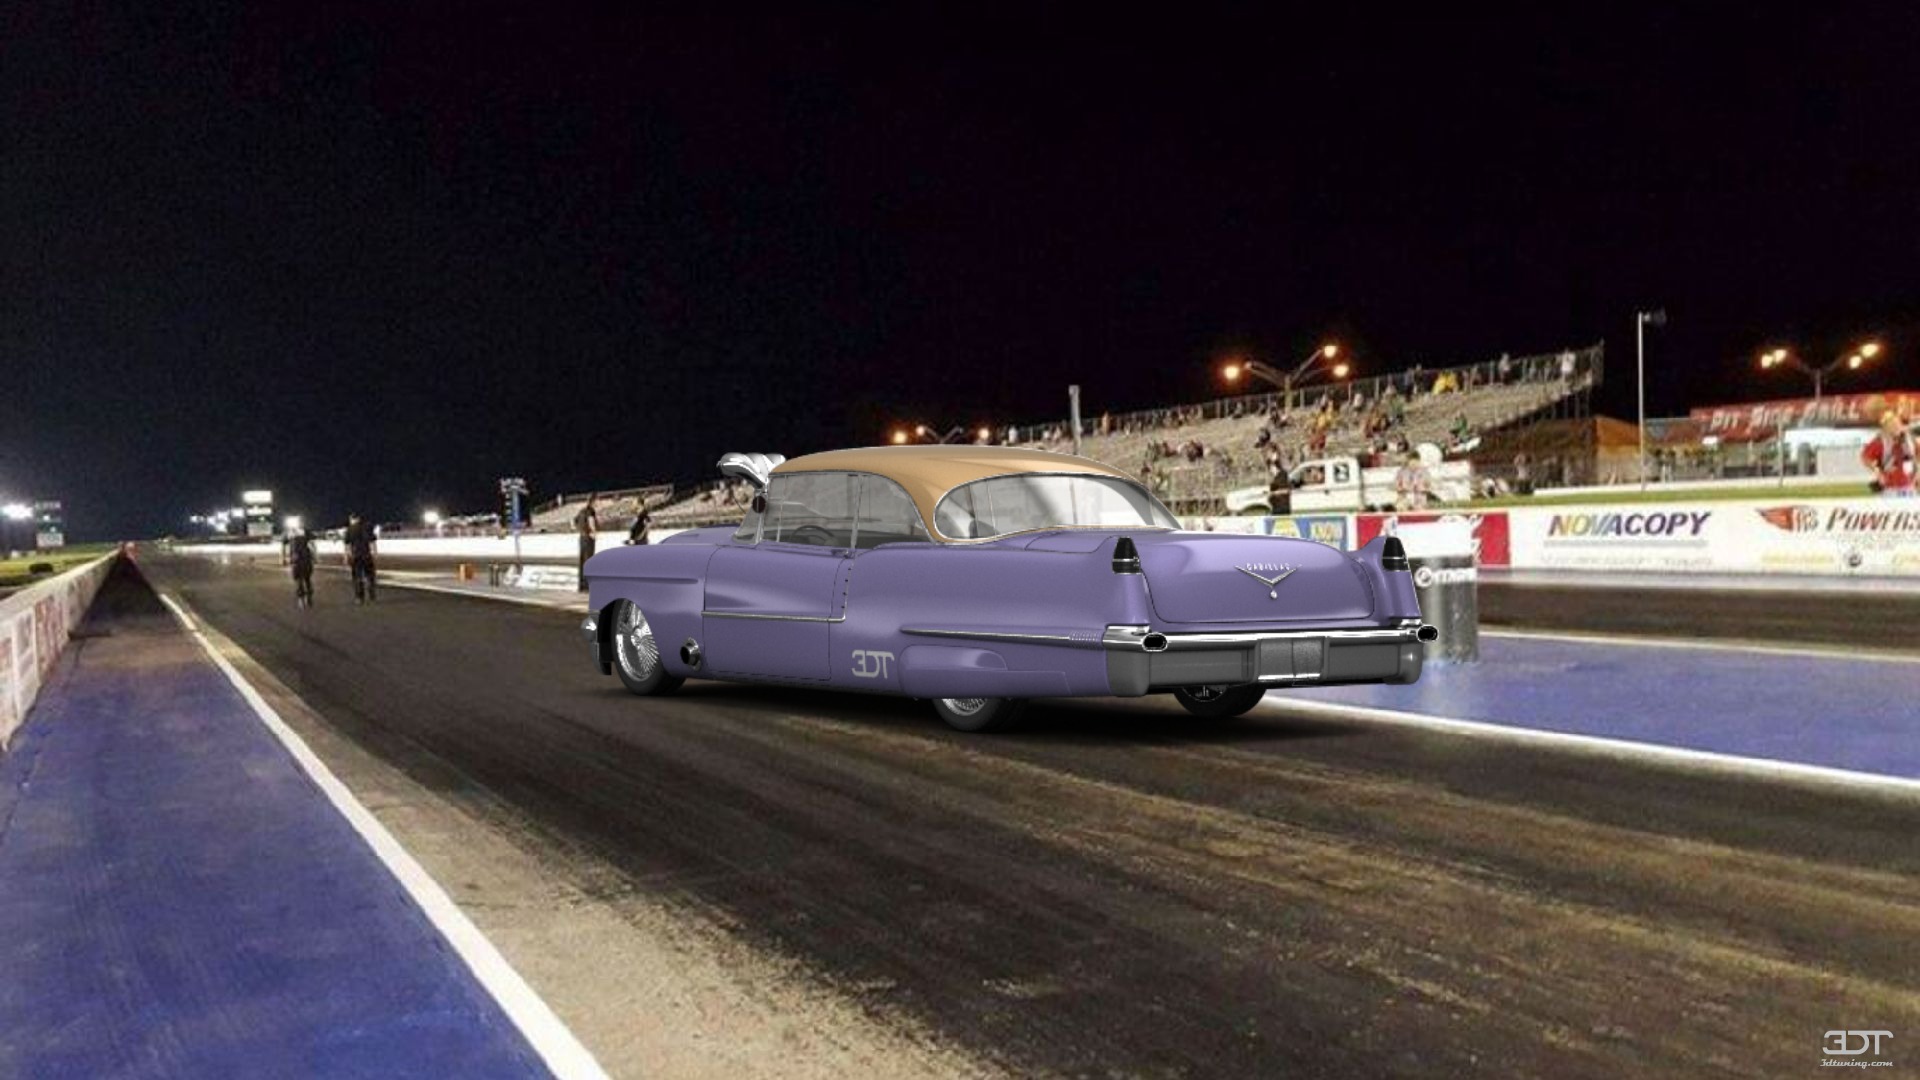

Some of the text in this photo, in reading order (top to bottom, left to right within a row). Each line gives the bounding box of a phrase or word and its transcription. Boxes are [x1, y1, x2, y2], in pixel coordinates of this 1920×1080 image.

[1548, 511, 1711, 537] NOVACOPY
[1246, 562, 1290, 571] CADILLAC
[851, 649, 895, 679] 3DT
